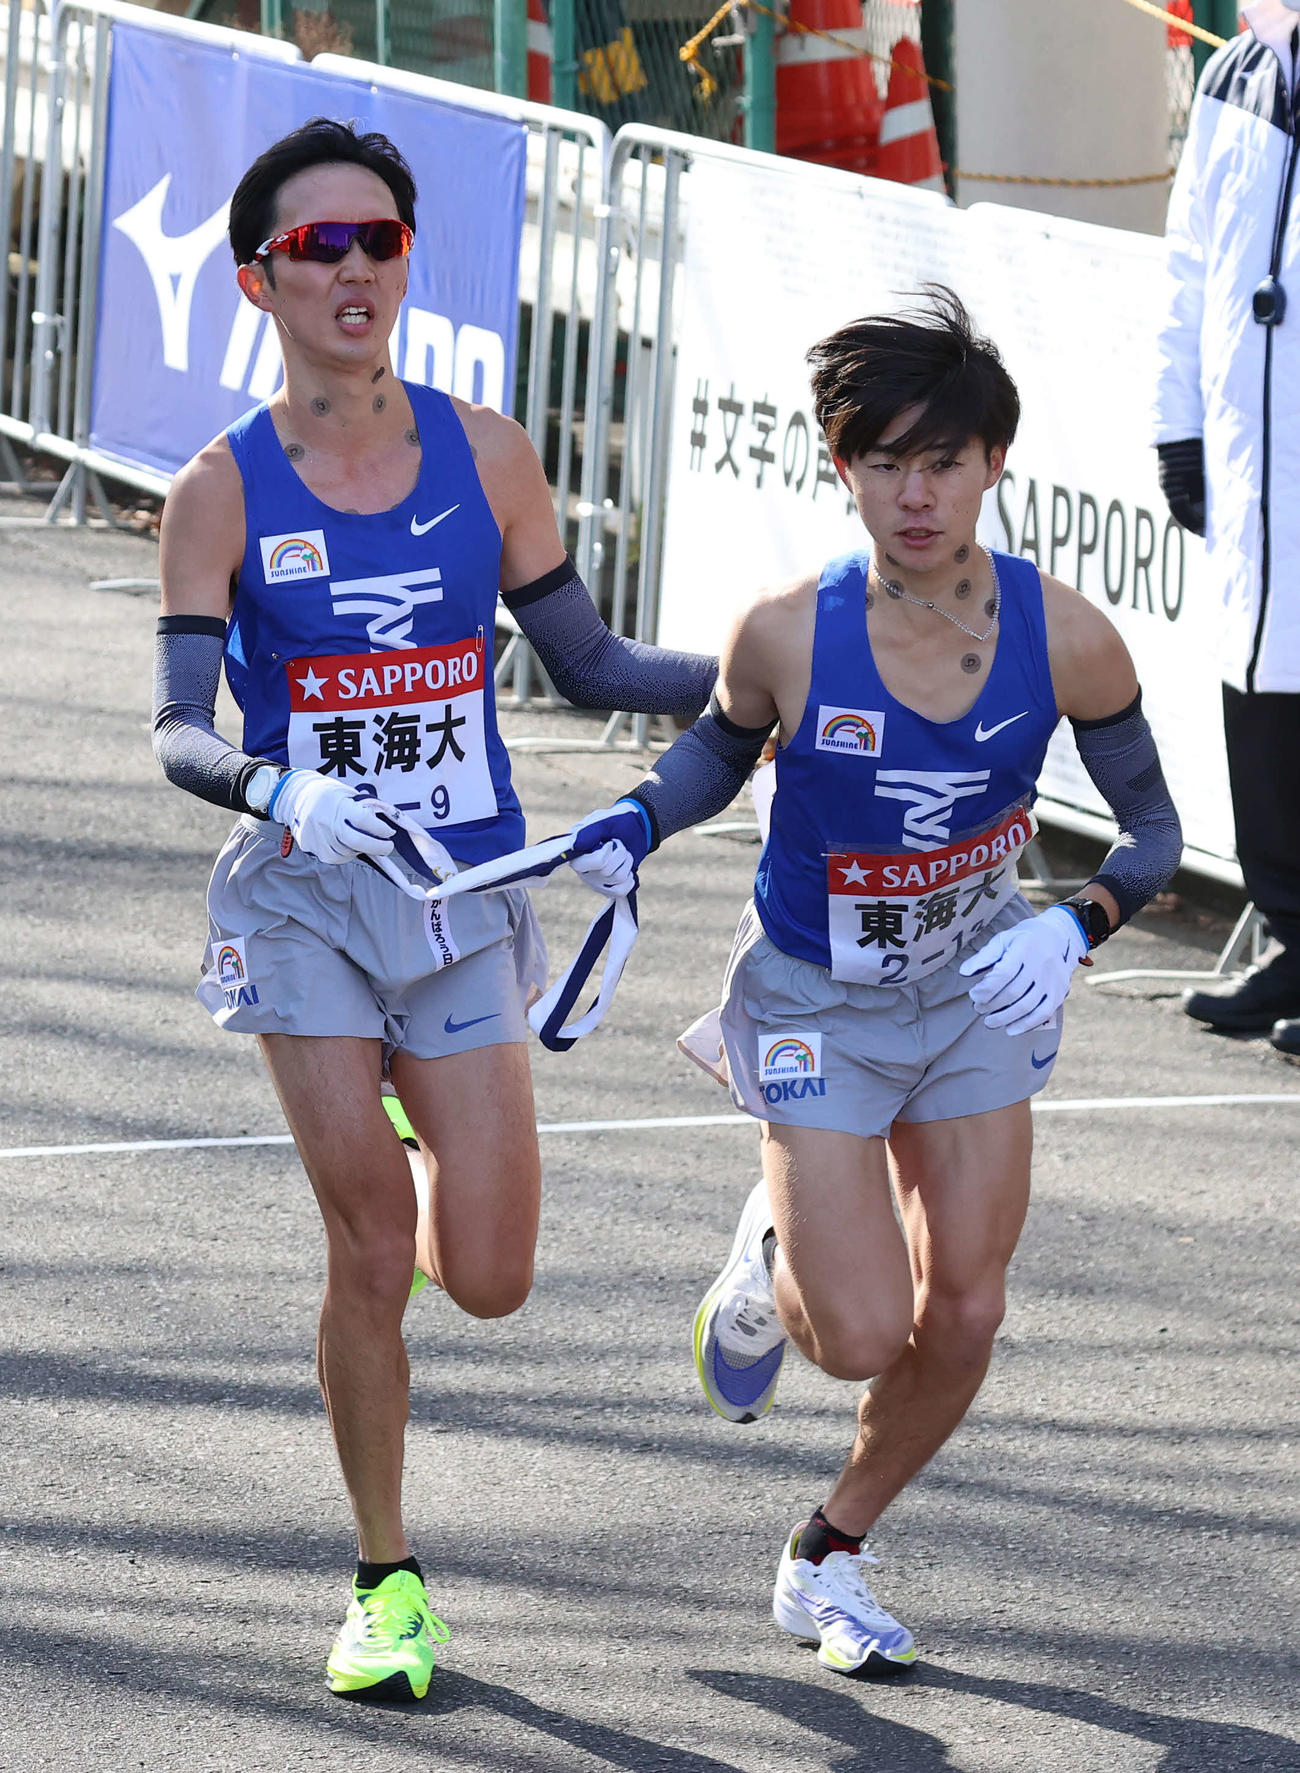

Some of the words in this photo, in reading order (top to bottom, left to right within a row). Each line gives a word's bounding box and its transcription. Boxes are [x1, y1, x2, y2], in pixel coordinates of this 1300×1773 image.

[270, 566, 307, 578] SUNSHINE
[997, 468, 1185, 623] SAPPORO
[337, 651, 479, 700] SAPPORO
[312, 703, 467, 778] 東海大
[821, 738, 859, 750] SUNSHINE
[882, 822, 1026, 889] SAPPORO
[855, 867, 1006, 949] 東海大
